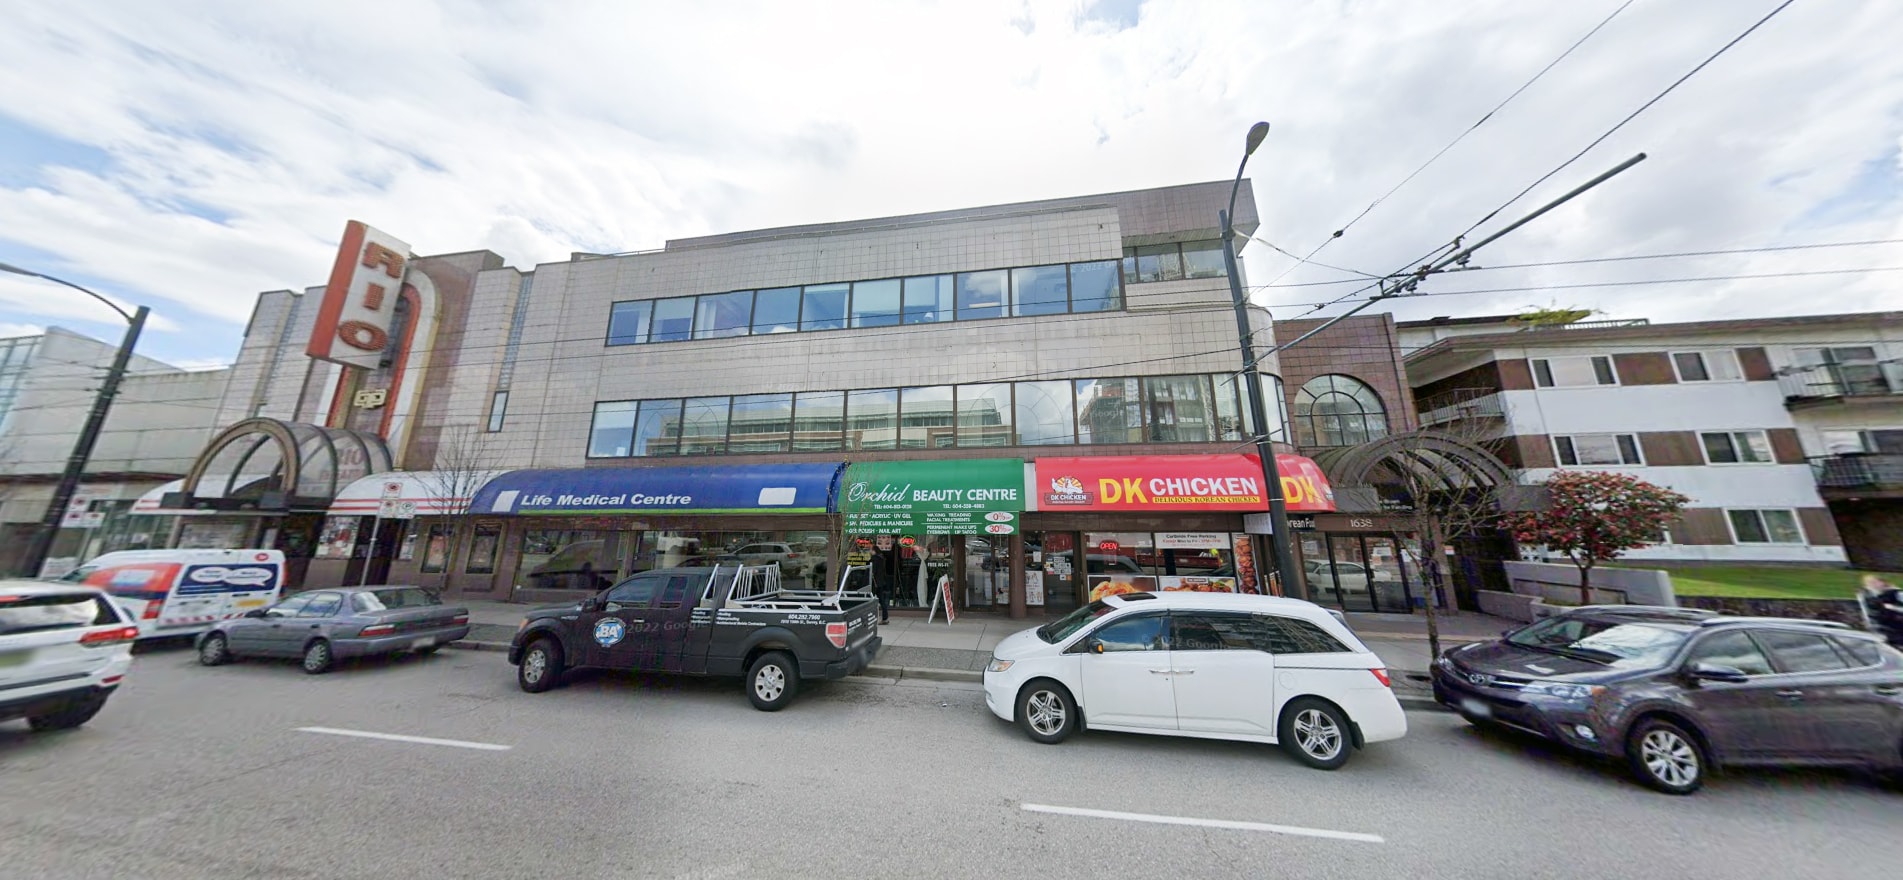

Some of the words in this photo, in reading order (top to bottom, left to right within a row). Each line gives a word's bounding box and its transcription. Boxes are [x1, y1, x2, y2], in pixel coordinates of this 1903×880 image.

[338, 241, 407, 352] RIO
[520, 494, 552, 506] Life
[556, 494, 627, 506] Medical
[630, 493, 691, 505] Centre
[848, 481, 911, 502] Orchid
[913, 489, 963, 501] BEAUTY
[967, 488, 1017, 501] CENTRE
[1098, 477, 1148, 504] DK
[1150, 477, 1259, 496] CHICKEN
[1280, 476, 1324, 504] DK
[1350, 518, 1373, 527] 1638
[1100, 542, 1117, 550] OPEN
